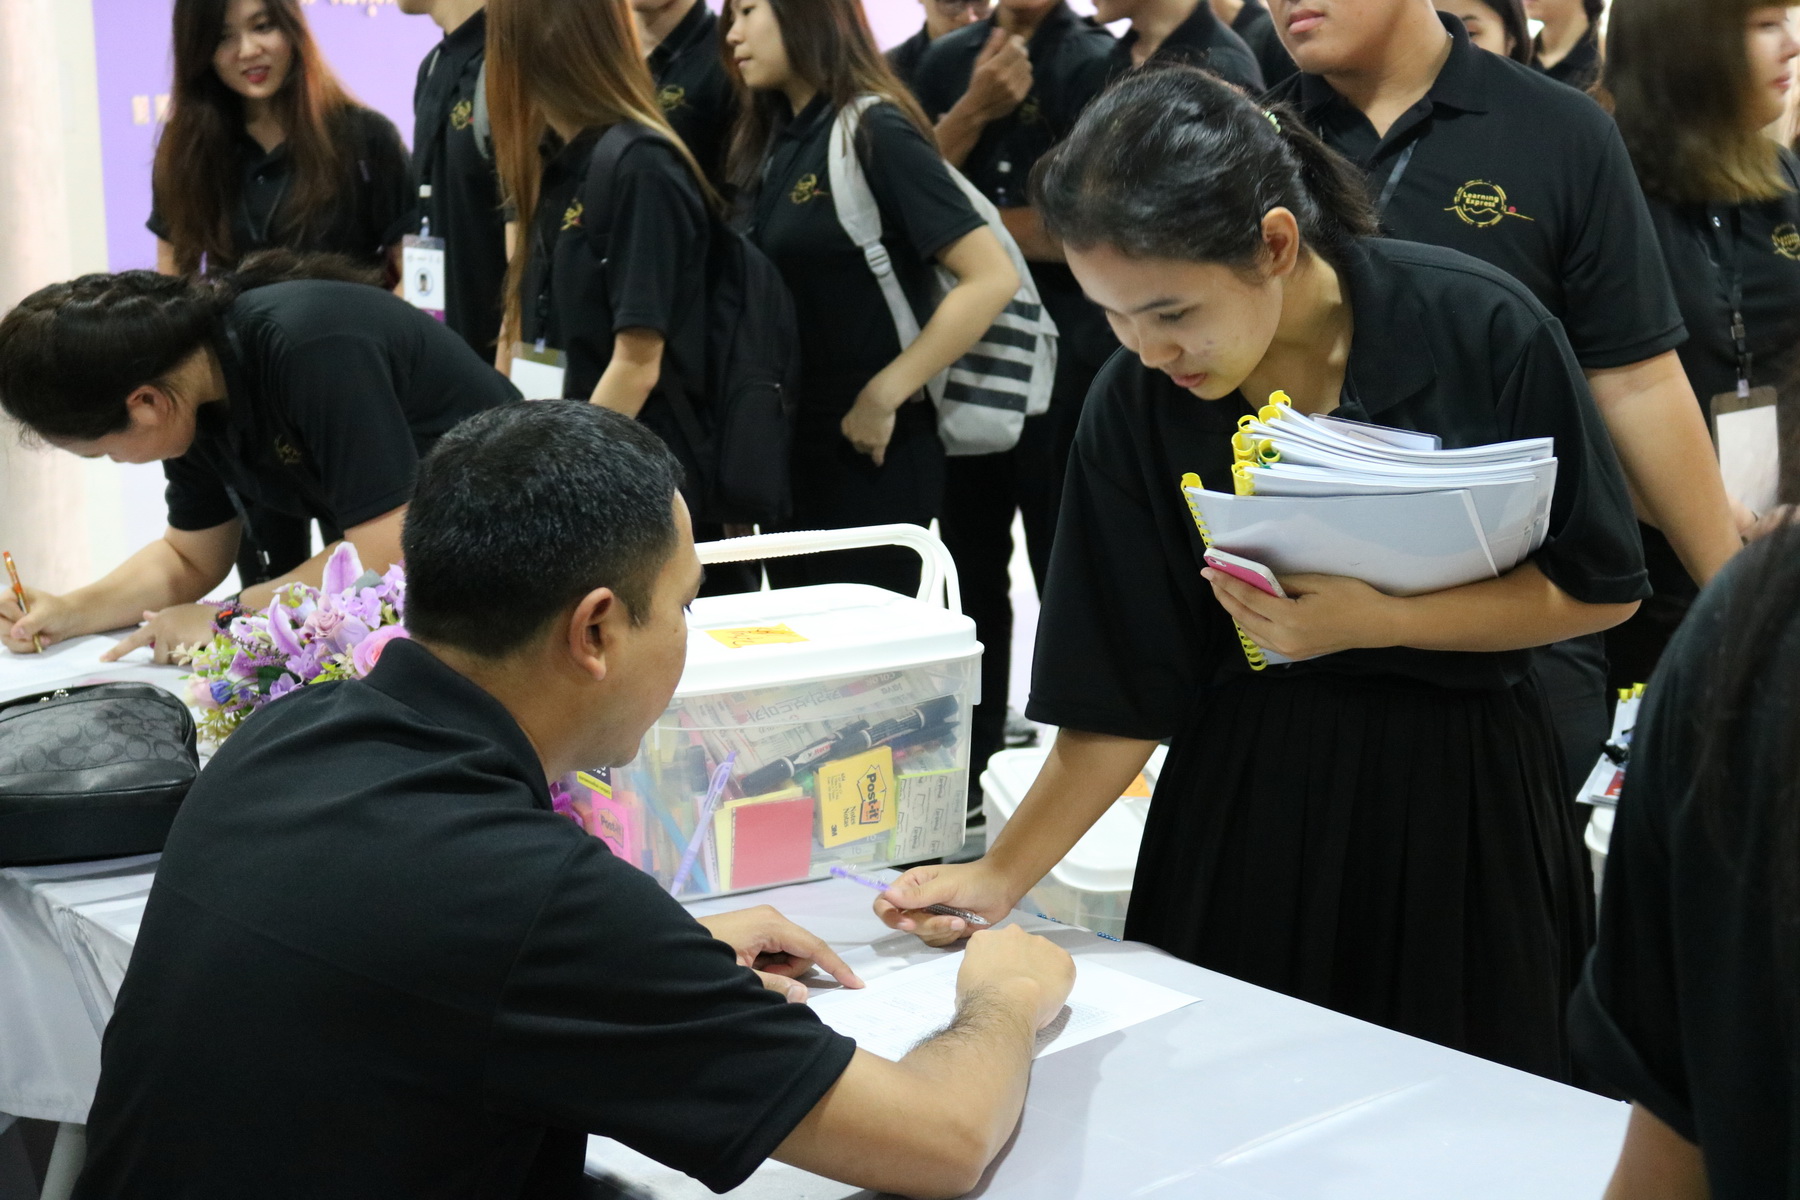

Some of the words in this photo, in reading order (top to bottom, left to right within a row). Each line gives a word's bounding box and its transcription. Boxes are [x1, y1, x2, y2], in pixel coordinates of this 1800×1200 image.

[1463, 191, 1499, 203] Learning
[1465, 197, 1496, 208] Express
[867, 772, 879, 820] Post-it
[831, 824, 838, 837] 3M
